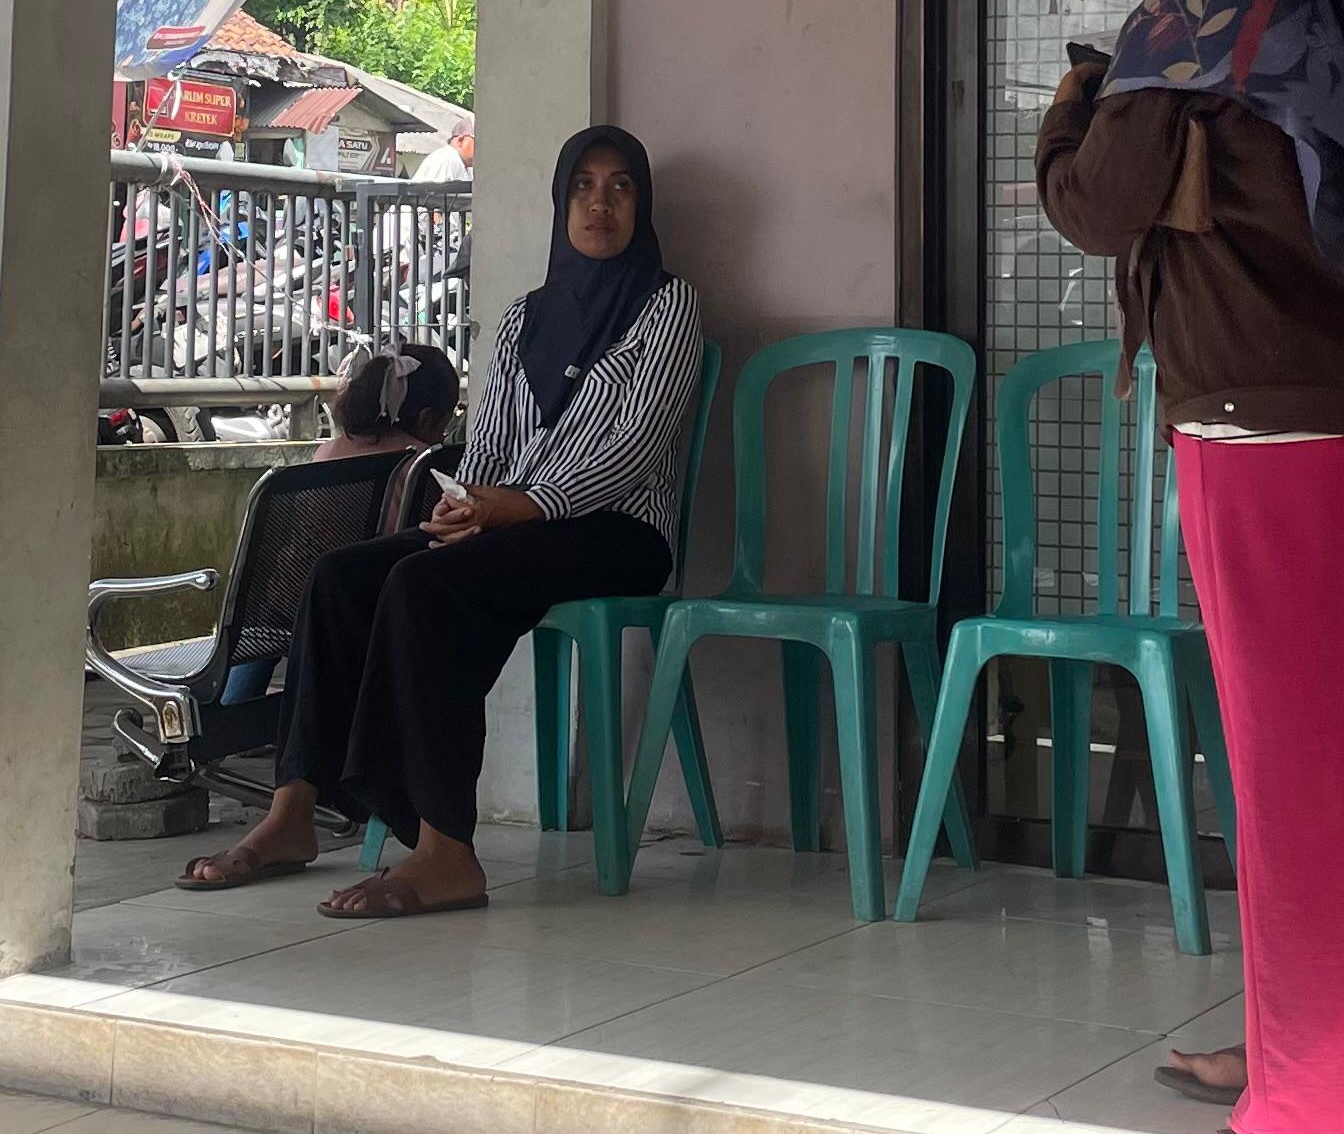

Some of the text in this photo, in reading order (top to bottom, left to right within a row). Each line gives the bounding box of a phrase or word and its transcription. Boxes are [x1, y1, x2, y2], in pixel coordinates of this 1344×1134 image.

[205, 92, 232, 107] SUPER
[185, 111, 218, 125] KRETEK
[346, 140, 368, 150] SATU
